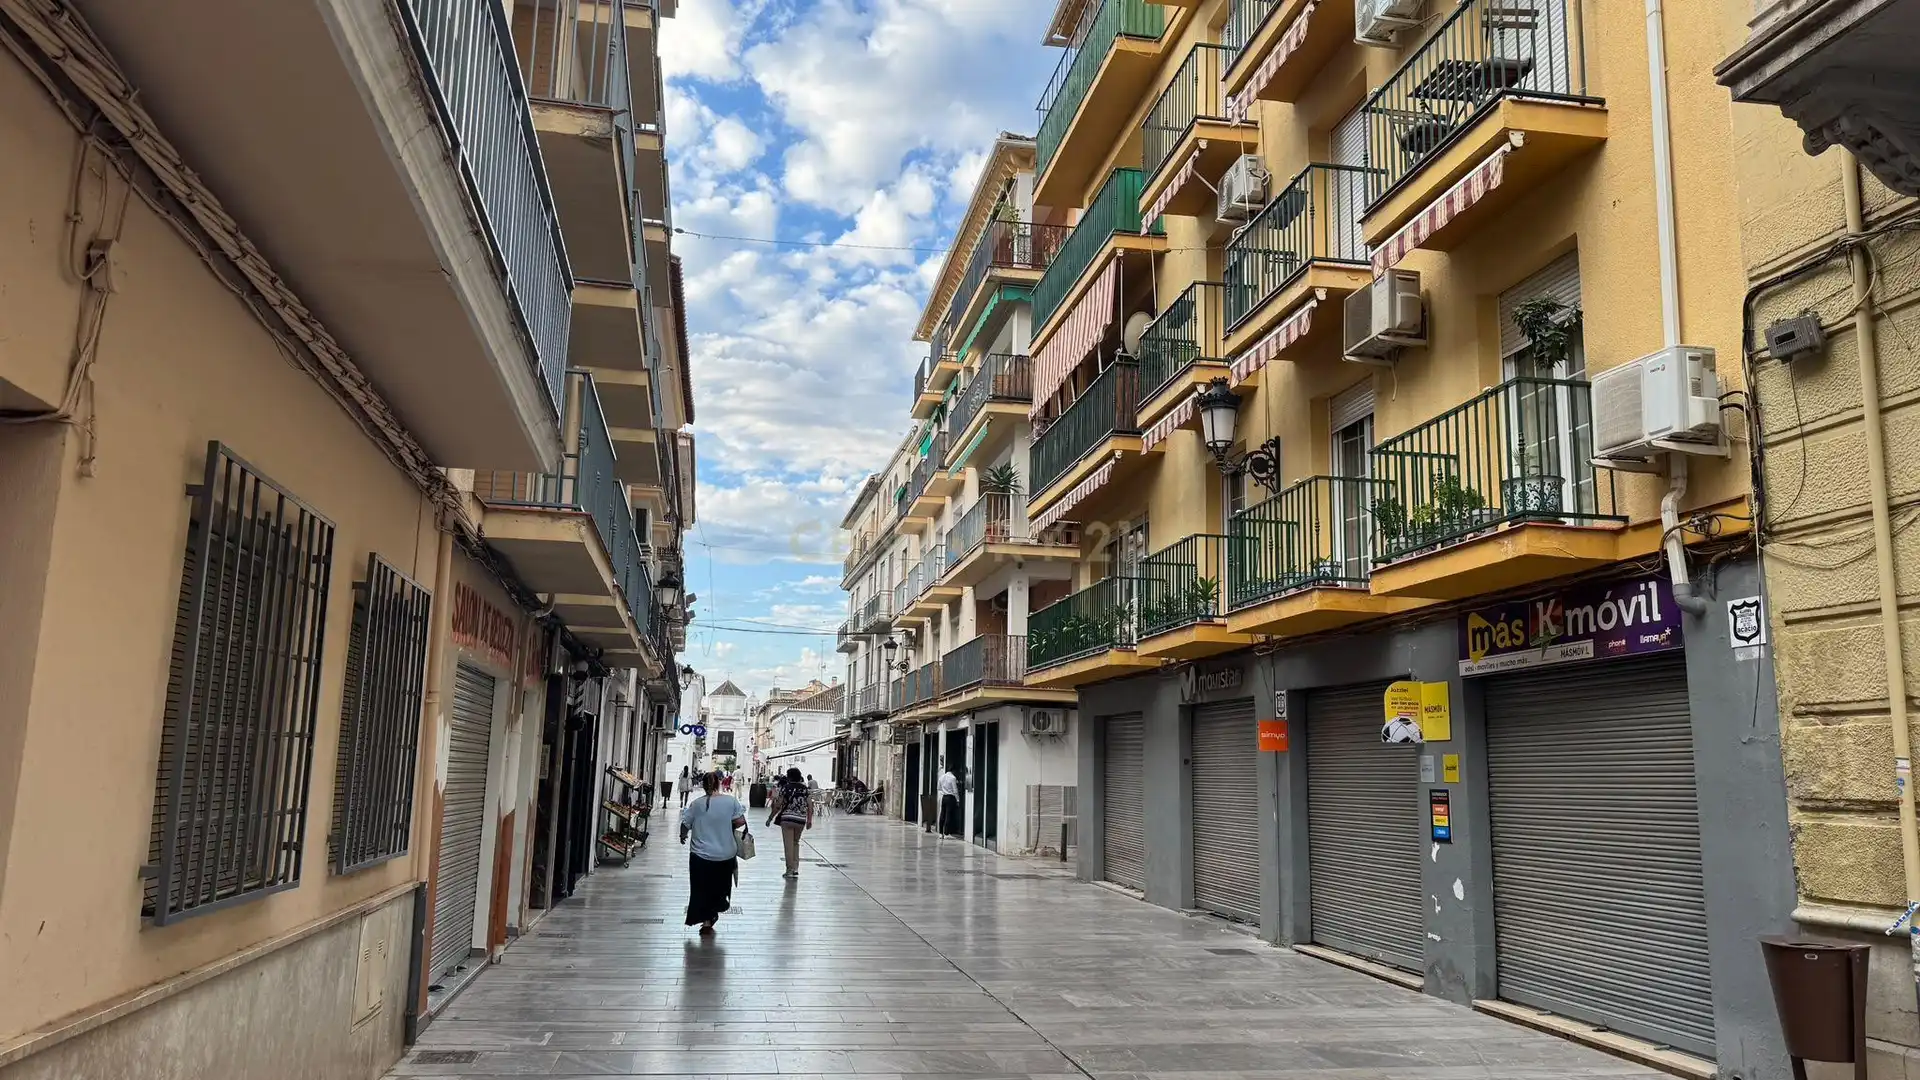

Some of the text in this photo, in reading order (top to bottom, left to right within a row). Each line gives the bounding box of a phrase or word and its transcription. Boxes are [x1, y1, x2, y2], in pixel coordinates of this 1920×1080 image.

[1535, 598, 1557, 637] K
[1564, 581, 1662, 637] móvil
[1260, 730, 1286, 741] simyo
